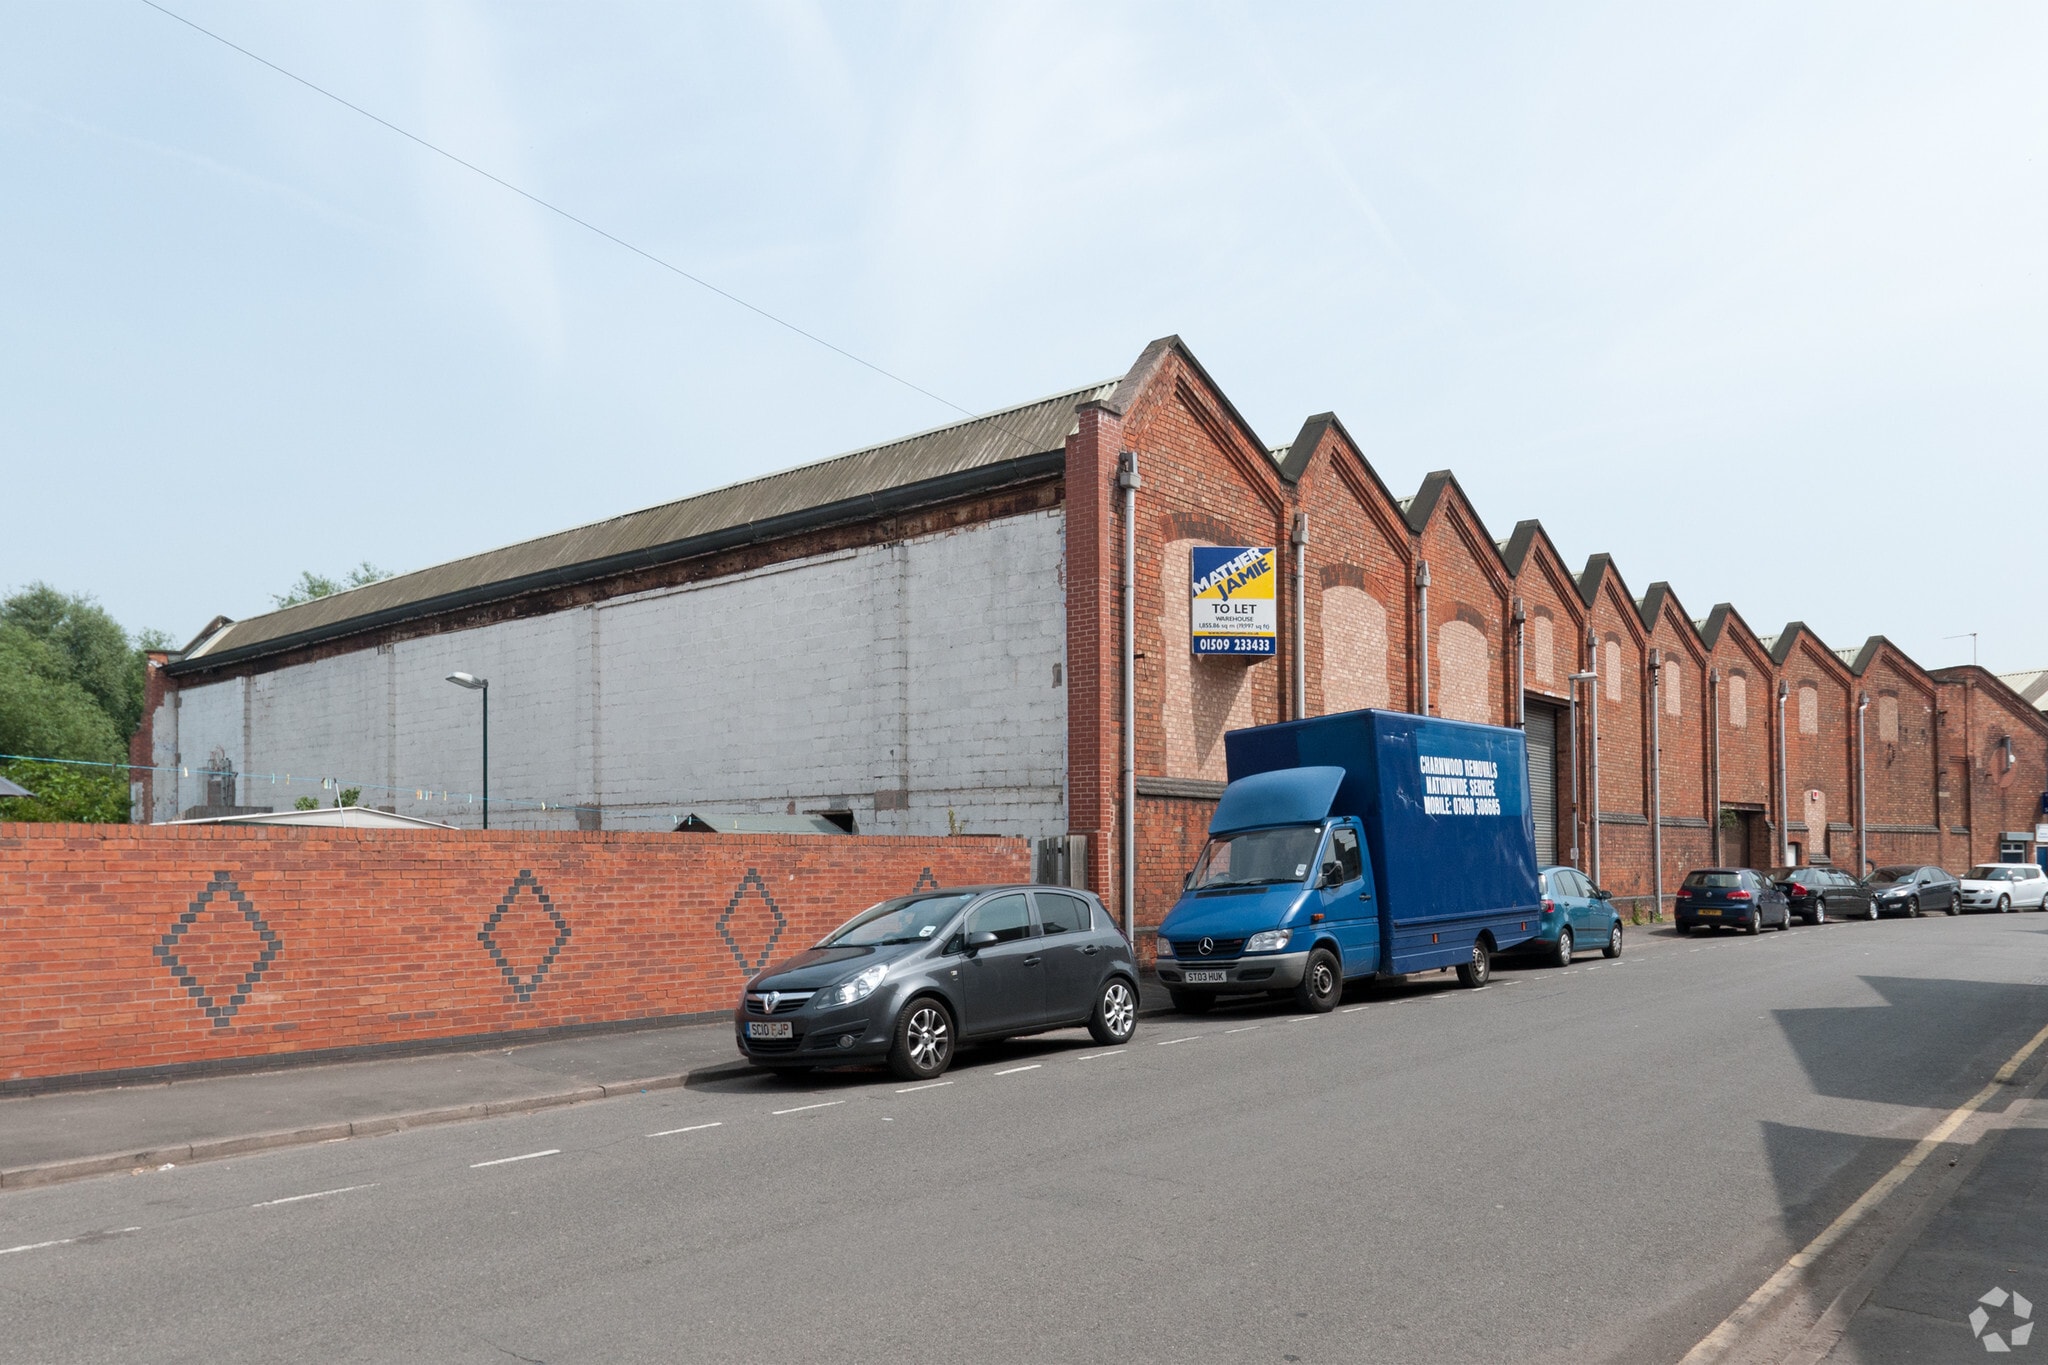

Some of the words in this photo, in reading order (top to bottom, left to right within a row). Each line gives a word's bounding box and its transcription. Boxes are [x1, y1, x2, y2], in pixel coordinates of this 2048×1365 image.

[1193, 547, 1263, 596] MATHER
[1215, 558, 1271, 601] JAMIE
[1212, 603, 1230, 614] TO
[1234, 604, 1257, 614] LET
[1200, 639, 1230, 650] 01509
[1234, 639, 1270, 651] 233433
[1420, 755, 1464, 776] CHARNWOOD
[1464, 759, 1498, 779] REMOVALS
[1425, 776, 1469, 796] NATIONWIDE
[1469, 779, 1496, 797] SERVICE
[1423, 796, 1452, 815] MOBILE:
[1453, 797, 1475, 815] 07980
[1208, 972, 1224, 981] HUK
